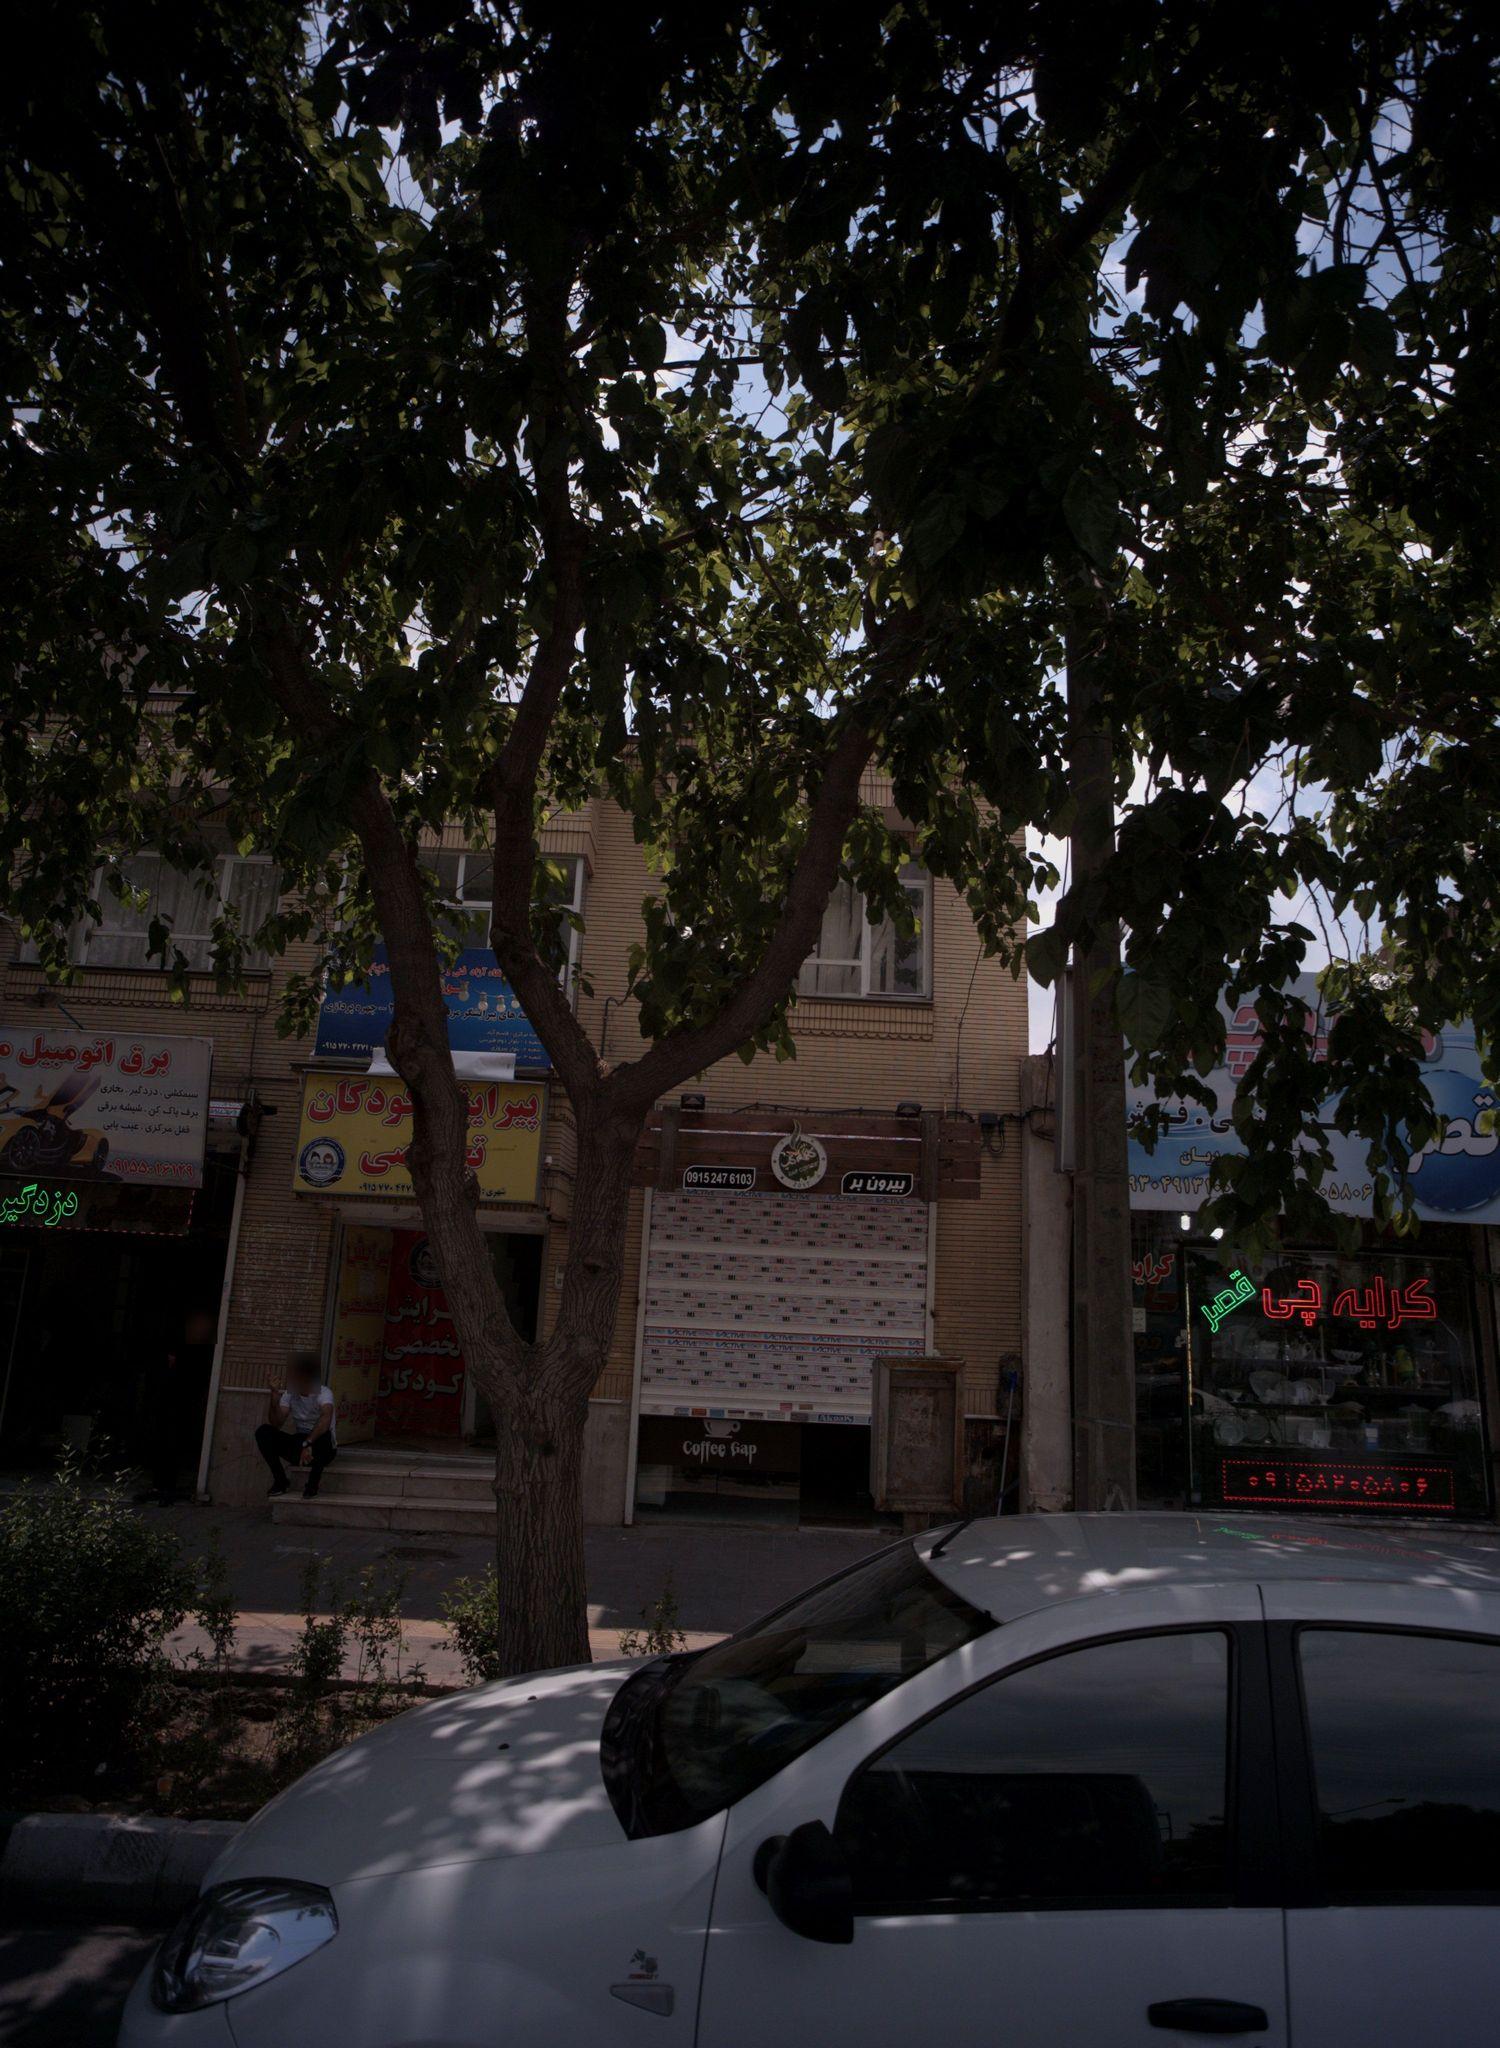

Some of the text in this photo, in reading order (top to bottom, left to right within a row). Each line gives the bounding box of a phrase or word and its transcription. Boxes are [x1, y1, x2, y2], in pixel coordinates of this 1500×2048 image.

[18, 1035, 115, 1071] اتومبیل
[120, 1044, 170, 1075] برق
[686, 1171, 752, 1185] 0915 247 6103
[1131, 1253, 1175, 1285] کرای
[1200, 1269, 1257, 1334] قصر
[1261, 1275, 1438, 1330] کرایه چی
[682, 1440, 758, 1465] Coffee Gap
